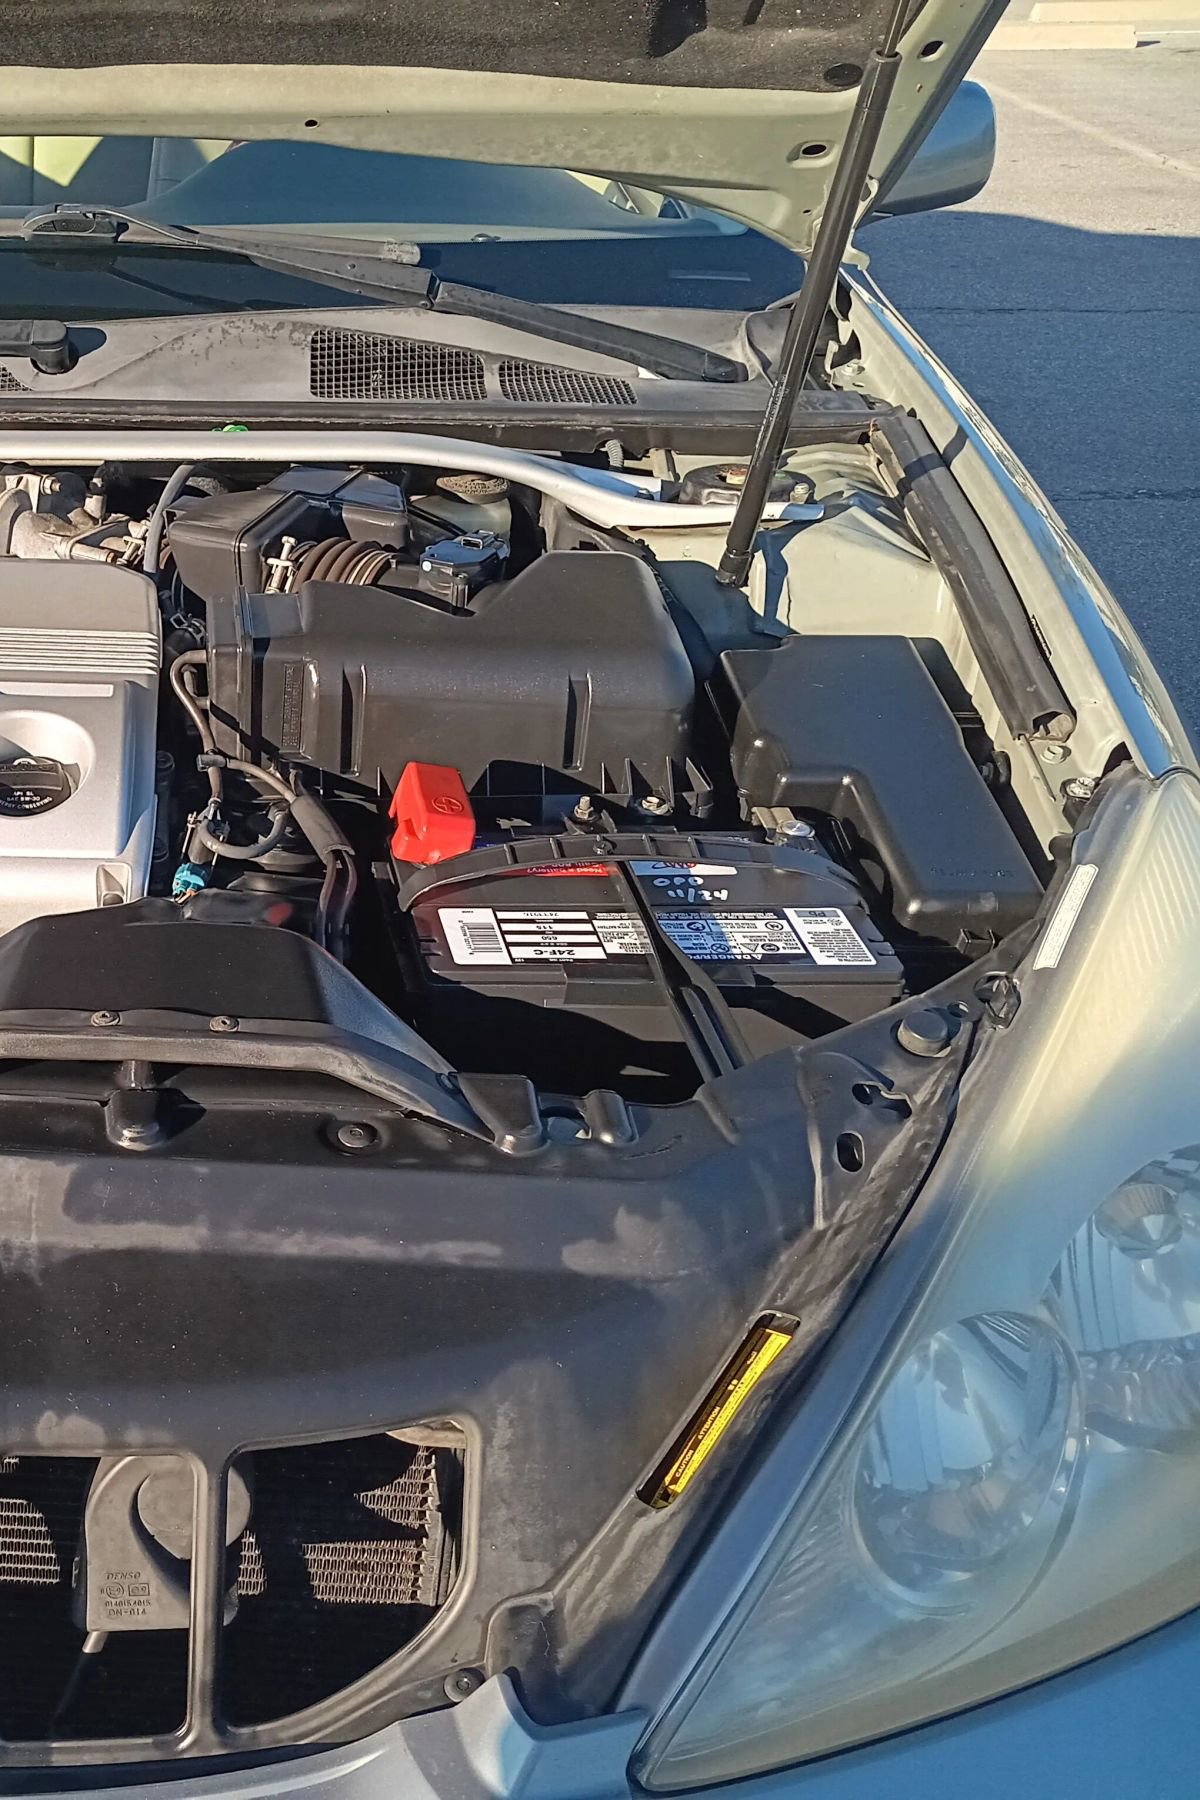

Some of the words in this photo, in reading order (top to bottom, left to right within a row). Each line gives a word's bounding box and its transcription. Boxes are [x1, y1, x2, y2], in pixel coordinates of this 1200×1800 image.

[667, 887, 729, 903] 11/24
[675, 1449, 694, 1477] CAUTION
[697, 1406, 720, 1440] ATTENTION
[104, 1571, 141, 1580] DENSO
